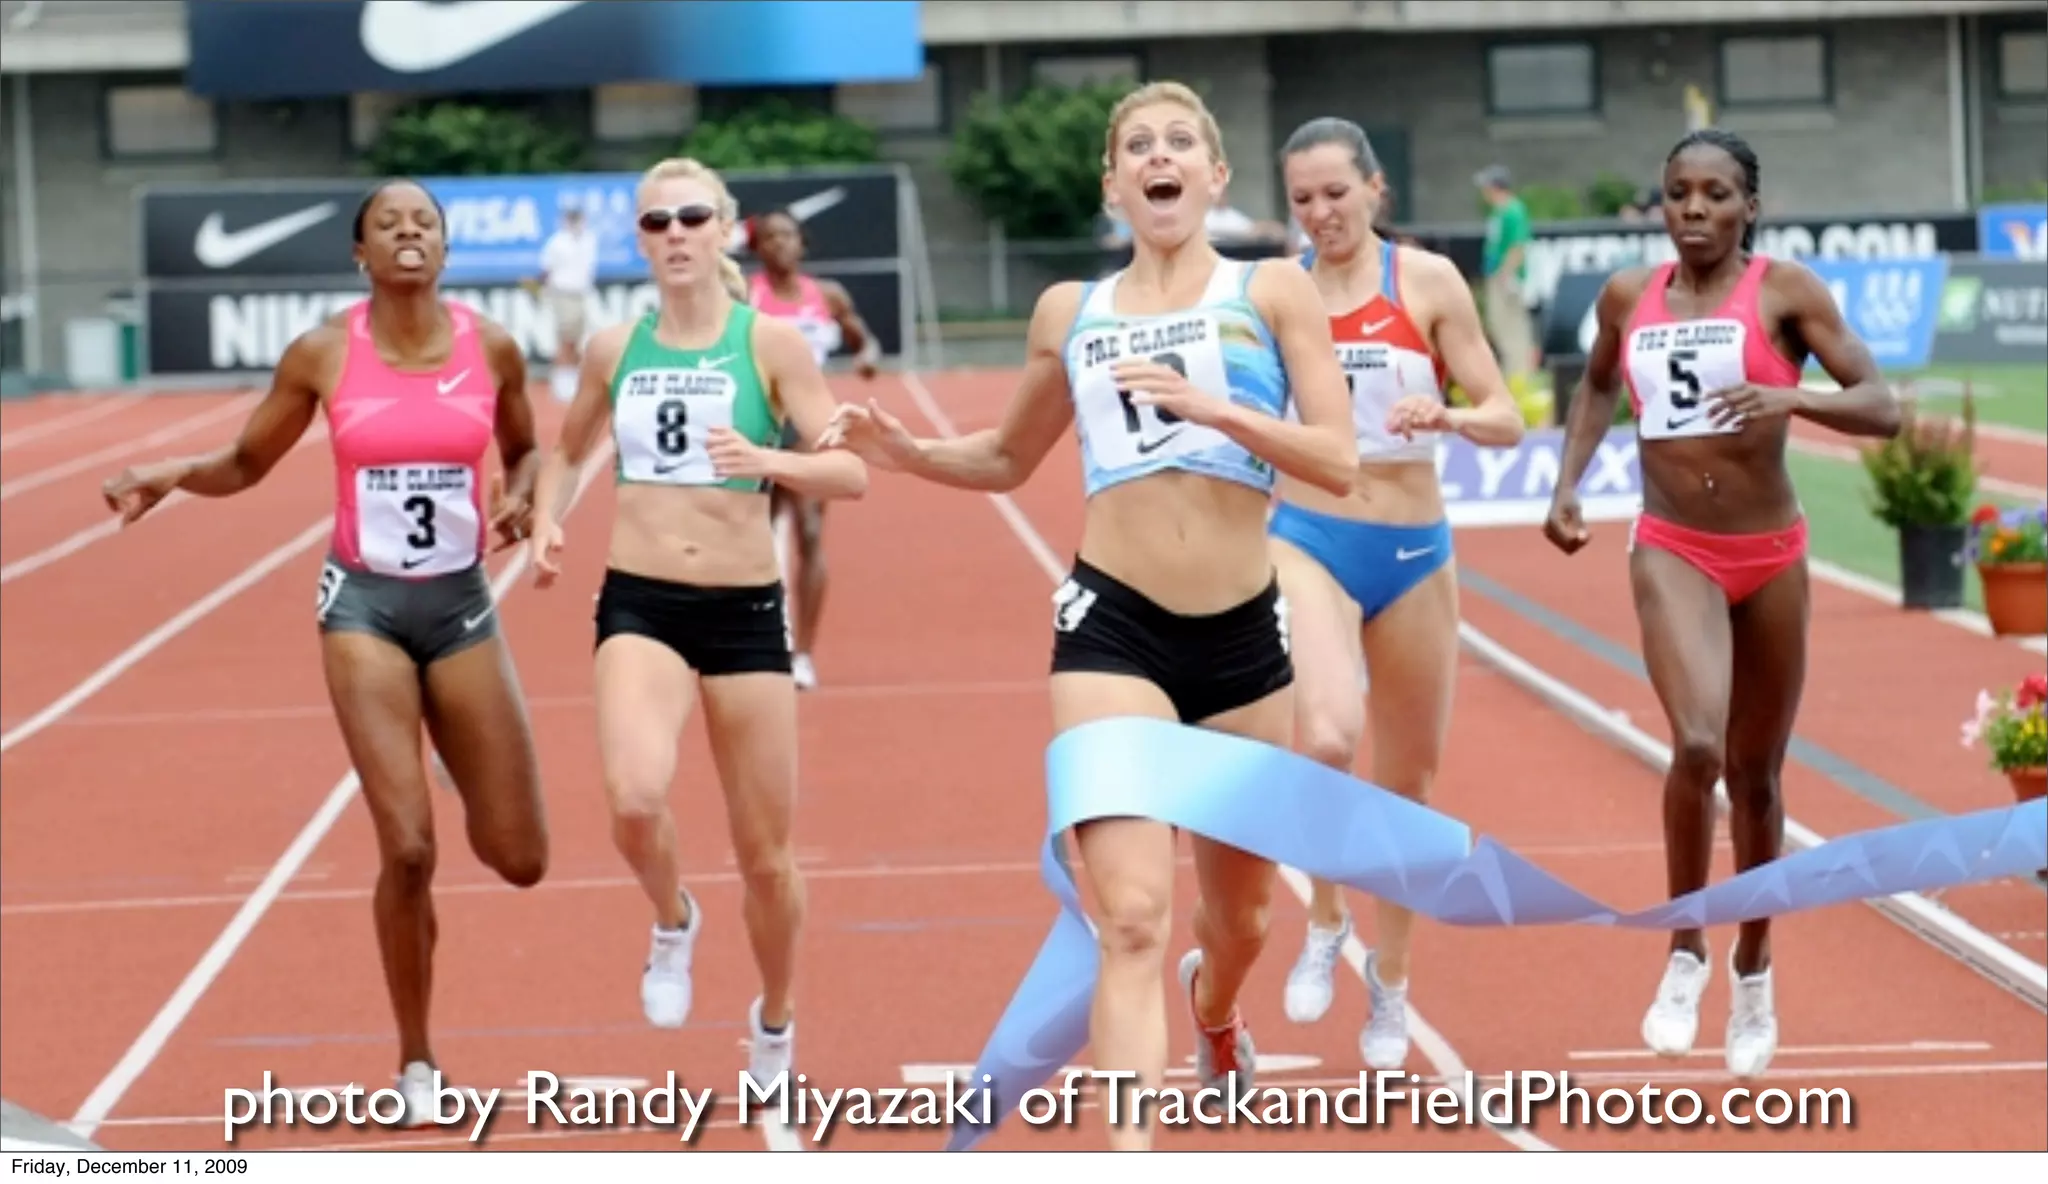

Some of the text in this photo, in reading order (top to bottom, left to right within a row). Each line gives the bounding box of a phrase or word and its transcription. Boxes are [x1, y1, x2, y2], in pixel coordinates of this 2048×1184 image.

[1668, 350, 1701, 410] 5
[656, 398, 688, 458] 8
[403, 493, 437, 550] 3
